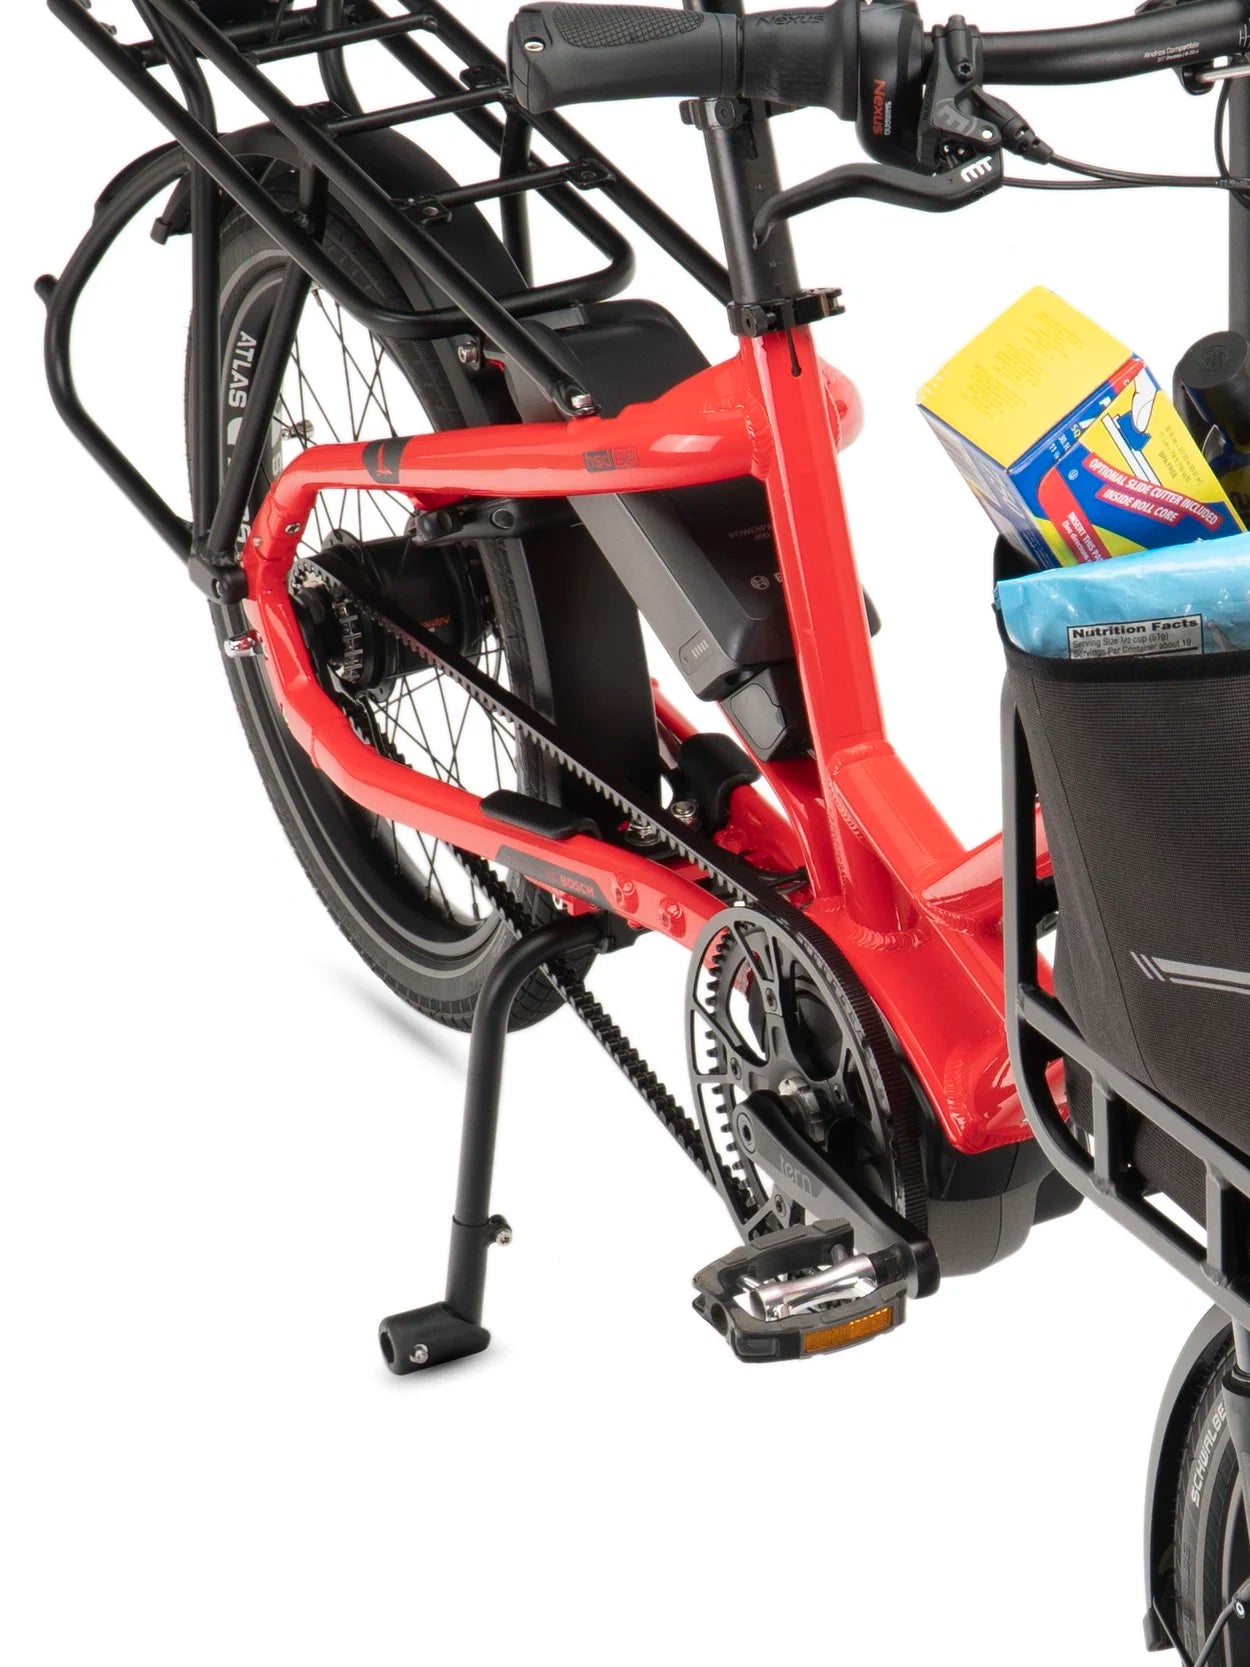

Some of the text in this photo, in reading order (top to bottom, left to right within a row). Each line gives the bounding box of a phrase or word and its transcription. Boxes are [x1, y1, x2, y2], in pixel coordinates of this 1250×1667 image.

[228, 330, 257, 409] ATLAS
[1088, 458, 1126, 486] OPTIONAL
[1125, 478, 1152, 495] SLIDE
[1149, 486, 1184, 506] CUTTER
[1180, 496, 1218, 526] INCLUDED
[1103, 488, 1179, 523] INSIDE ROLL CORE
[1072, 639, 1101, 649] Serving
[1103, 637, 1119, 646] Size
[1132, 636, 1147, 646] cup
[1148, 631, 1169, 643] (51g)
[1073, 619, 1199, 639] Nutrition Facts
[1107, 647, 1121, 655] Per
[1122, 643, 1158, 654] Container
[1159, 640, 1181, 650] about
[1181, 637, 1192, 647] 19
[559, 874, 597, 898] BOSCH
[780, 1154, 812, 1195] tern
[1190, 1402, 1227, 1509] SCHWALBE
